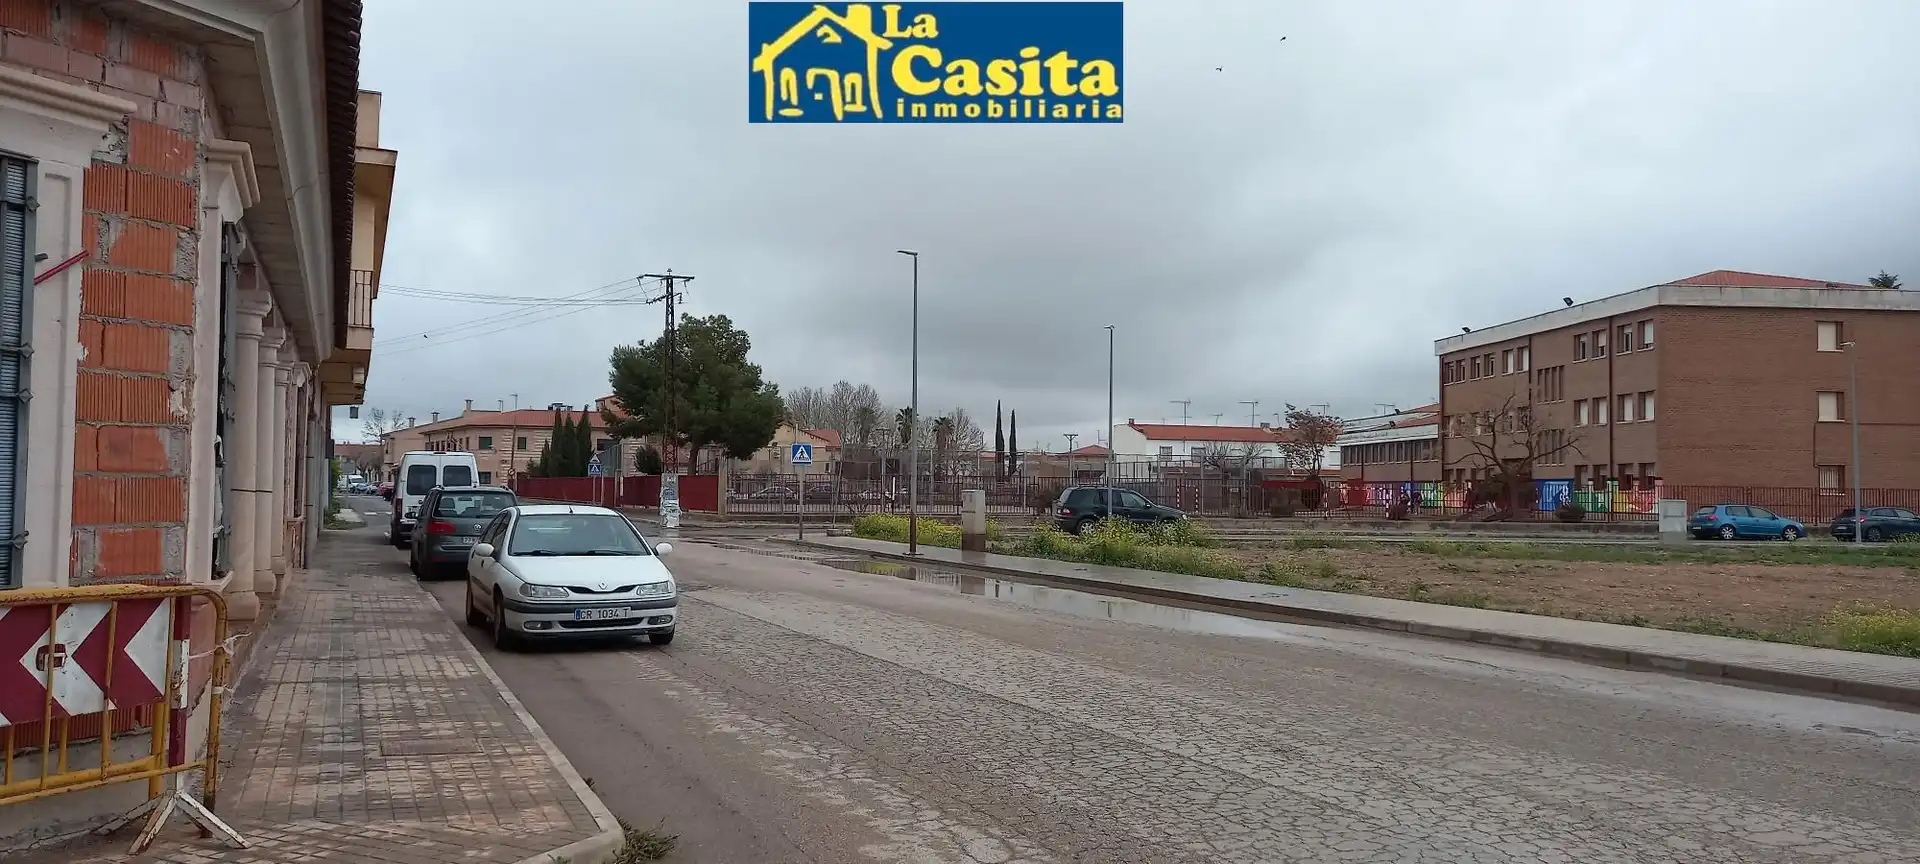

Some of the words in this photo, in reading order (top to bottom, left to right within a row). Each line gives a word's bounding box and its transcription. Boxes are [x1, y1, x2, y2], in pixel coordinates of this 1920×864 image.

[580, 610, 593, 620] CR
[597, 609, 619, 619] 1034
[623, 608, 630, 618] T
